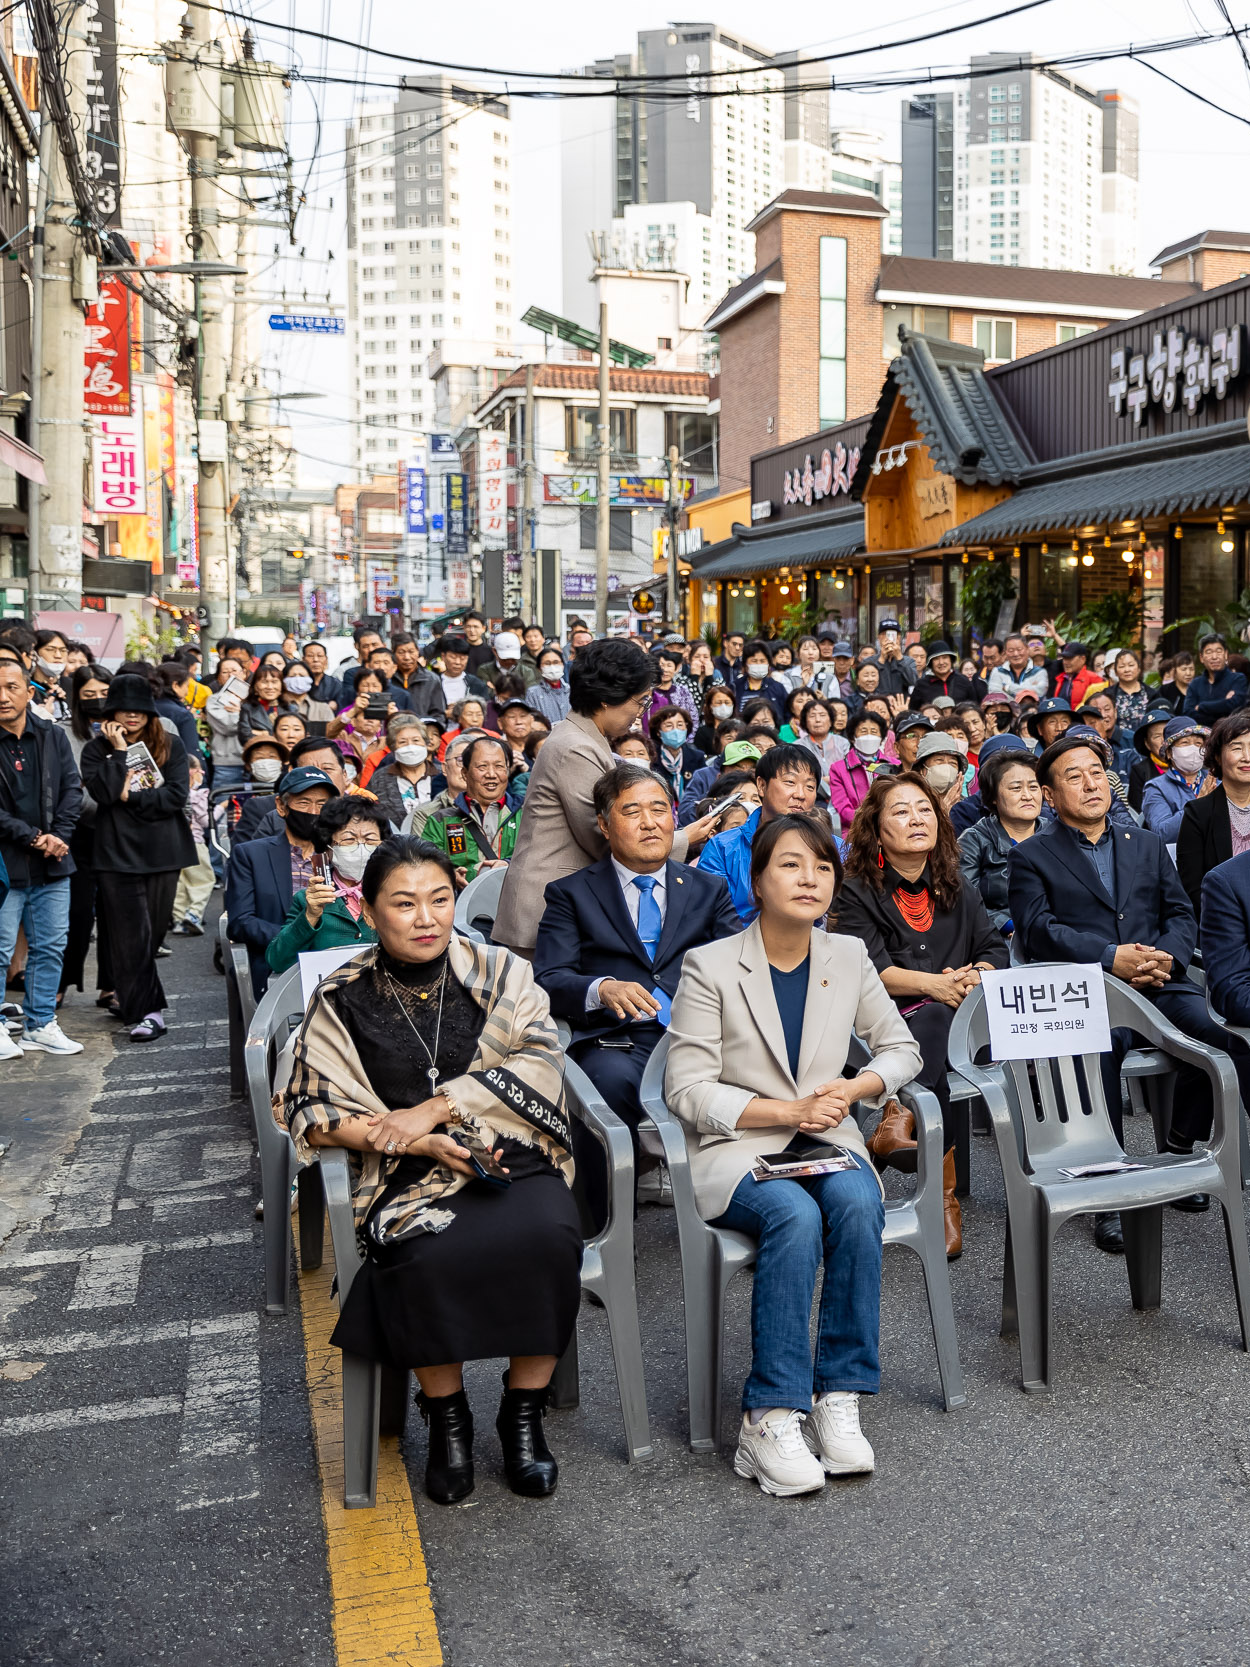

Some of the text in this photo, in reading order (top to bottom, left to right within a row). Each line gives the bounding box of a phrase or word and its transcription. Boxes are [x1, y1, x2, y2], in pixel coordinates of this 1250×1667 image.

[101, 421, 142, 508] 노래방
[999, 981, 1090, 1014] 내빈석
[1043, 1019, 1085, 1031] 국회의원
